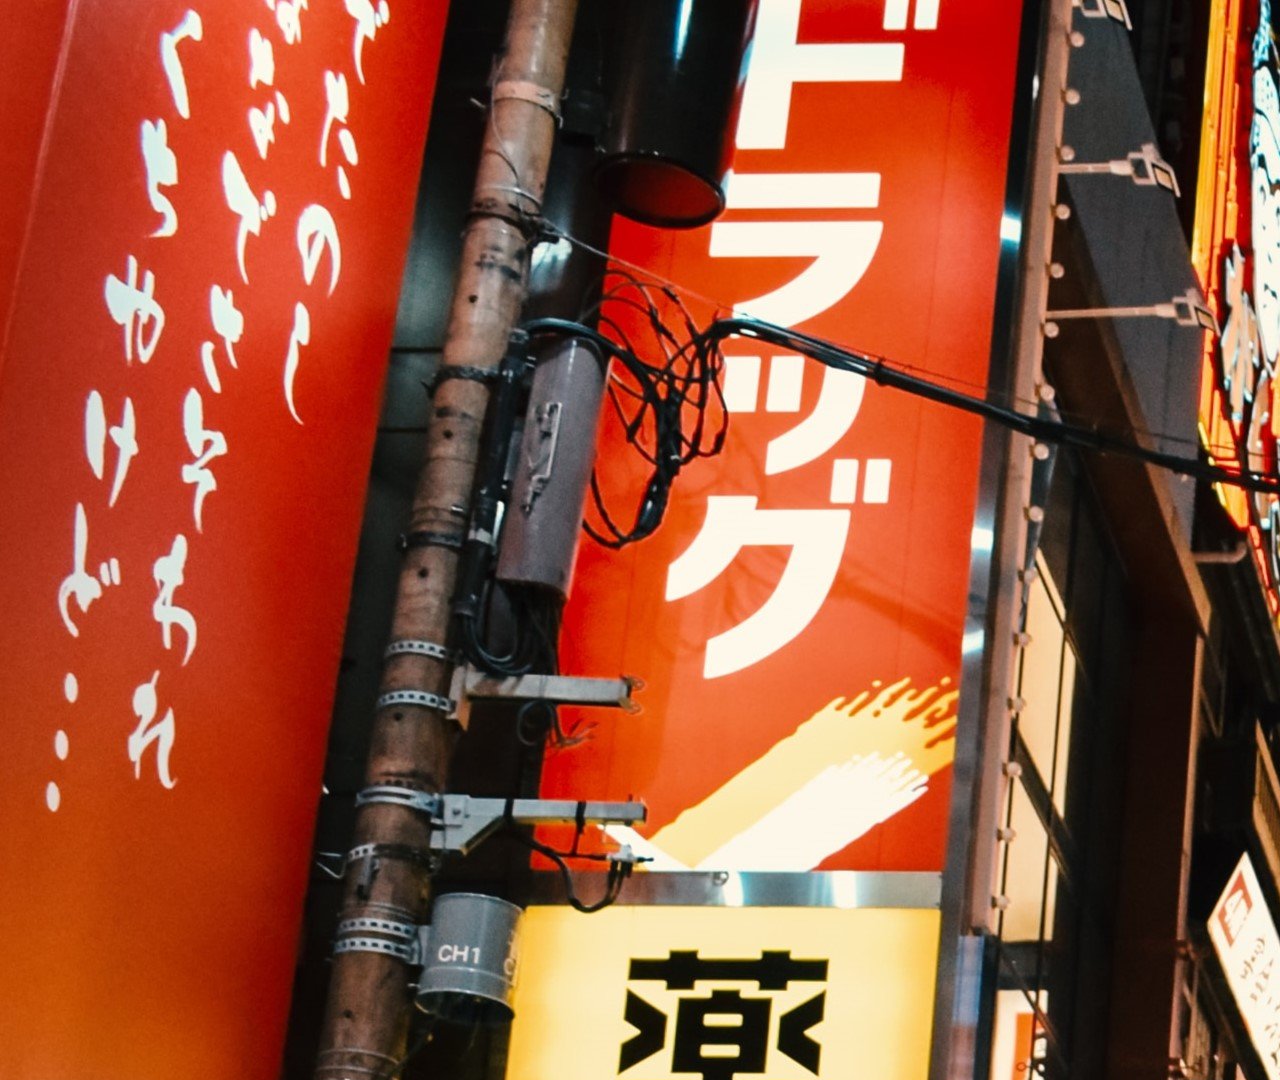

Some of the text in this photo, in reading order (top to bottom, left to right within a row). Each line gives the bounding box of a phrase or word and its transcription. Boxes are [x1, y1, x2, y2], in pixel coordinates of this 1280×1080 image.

[666, 0, 939, 678] ドラッグ
[438, 944, 482, 964] CH1
